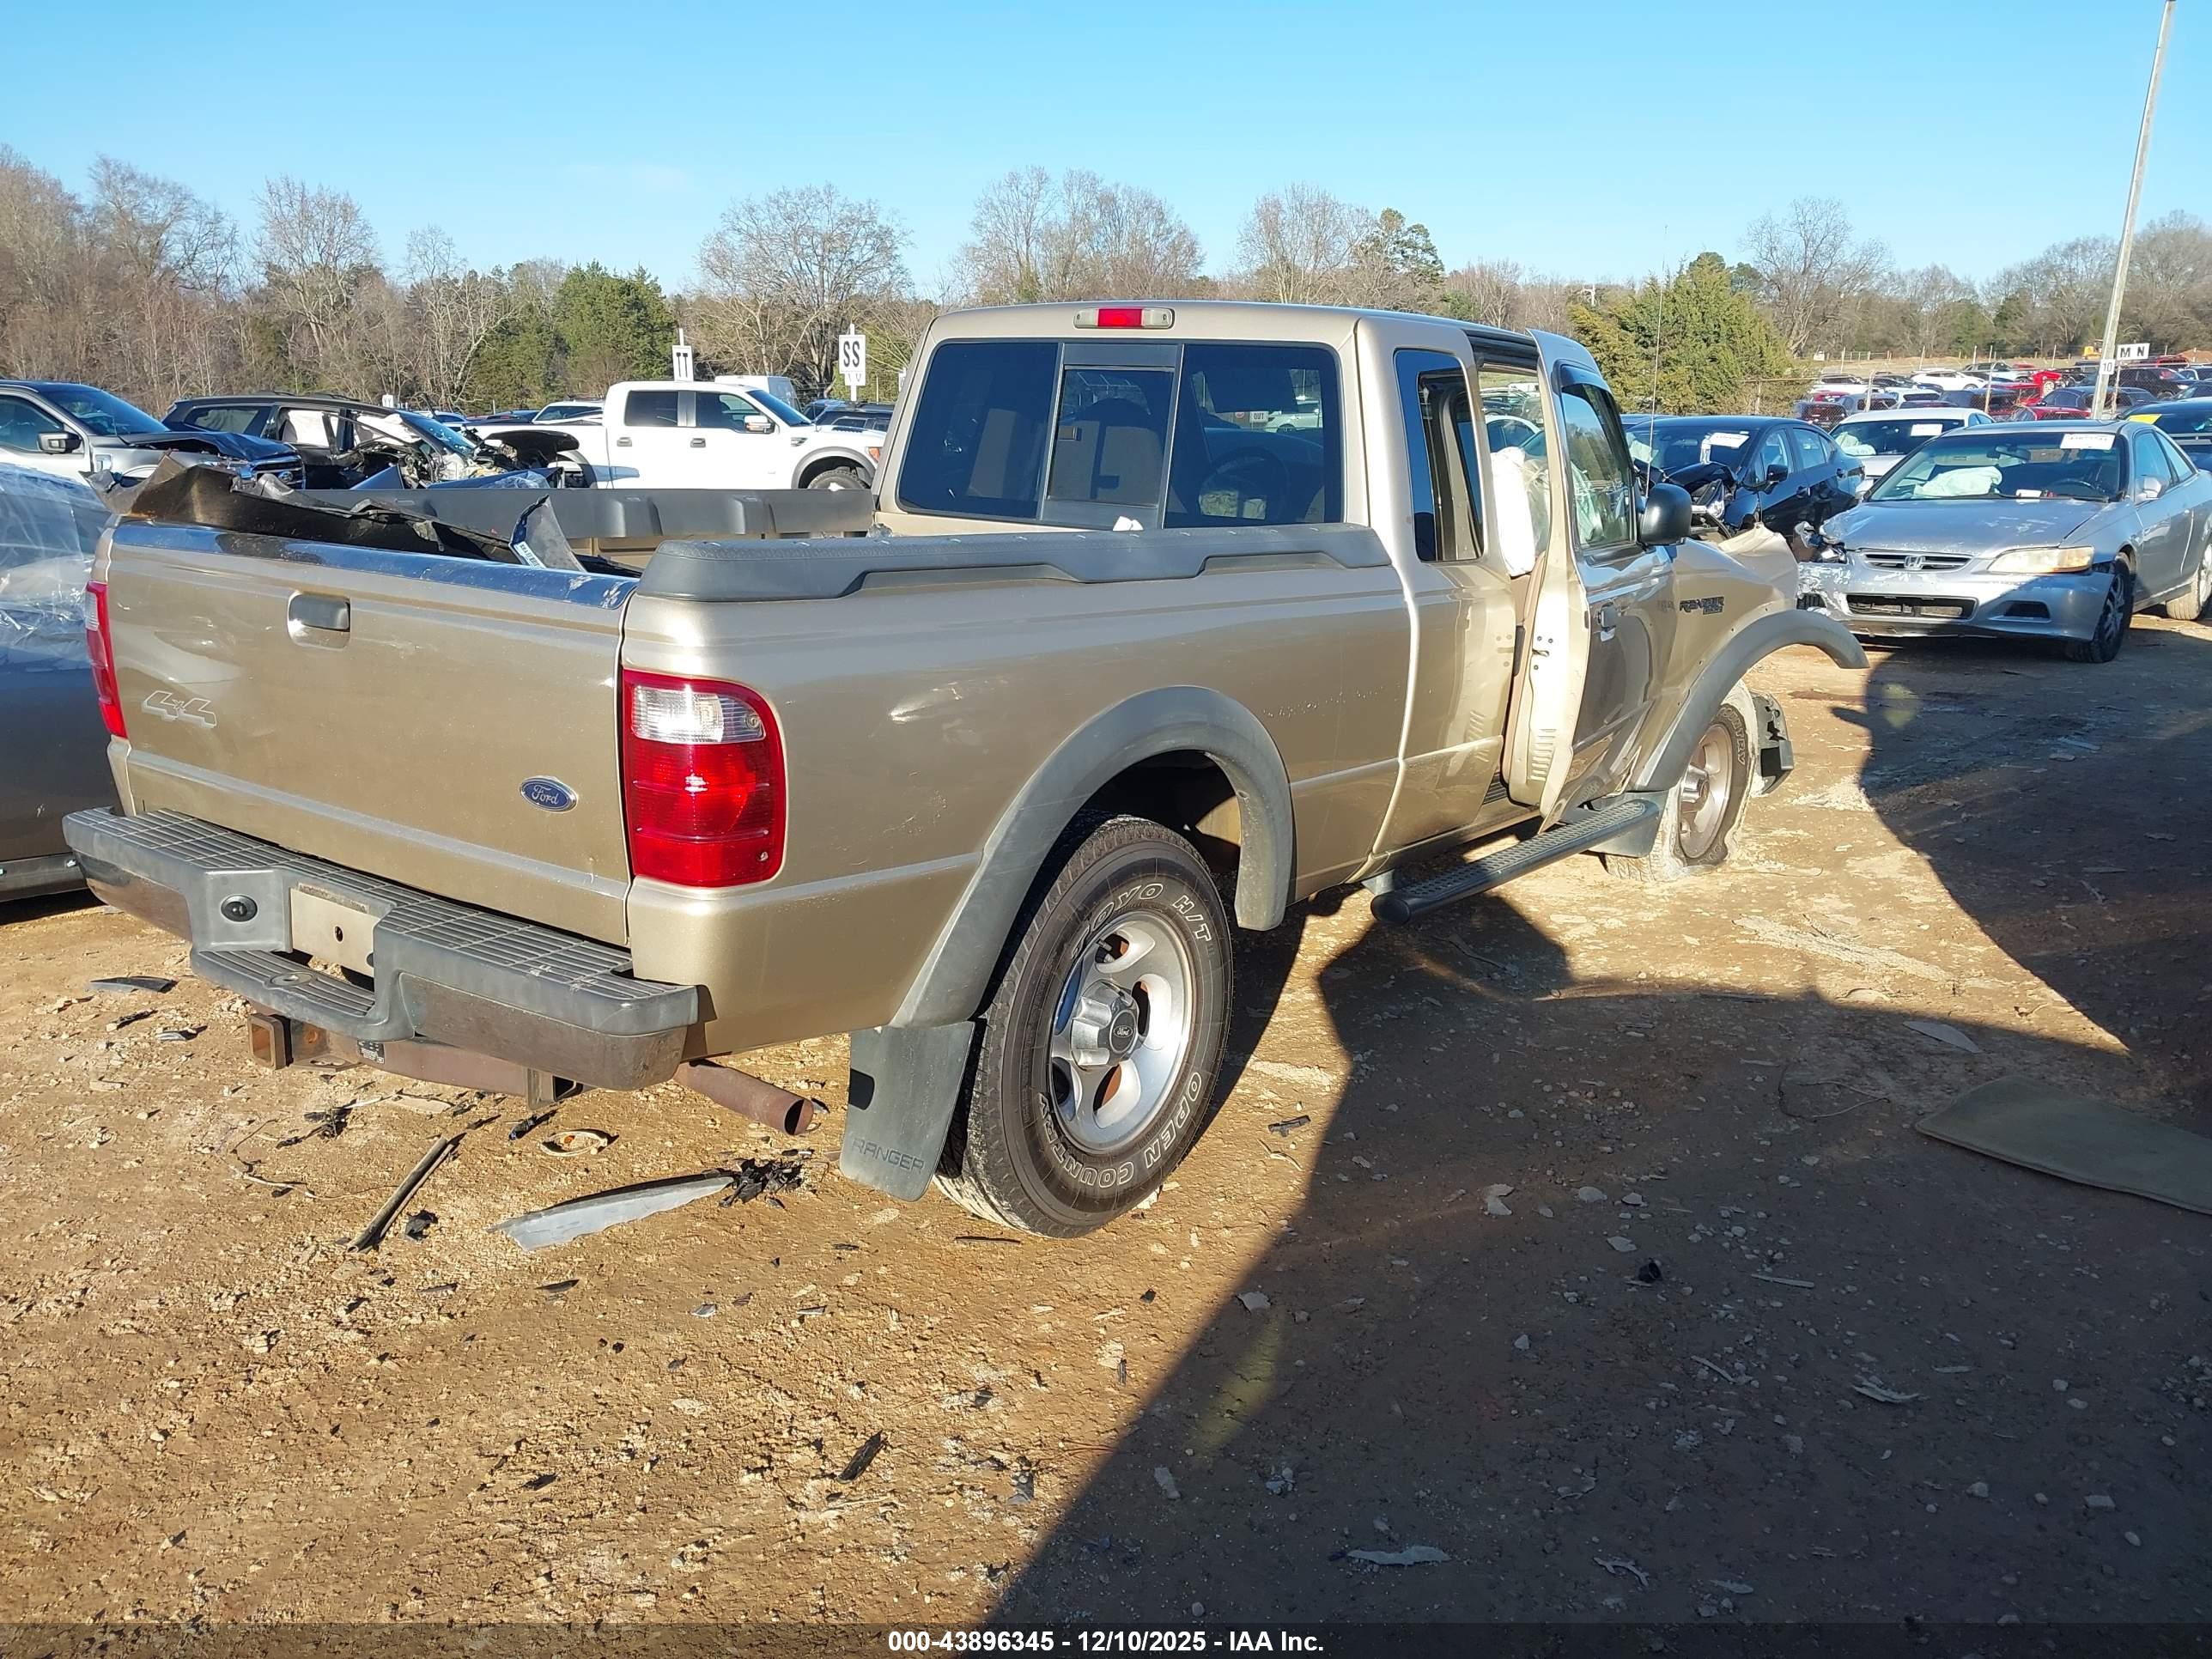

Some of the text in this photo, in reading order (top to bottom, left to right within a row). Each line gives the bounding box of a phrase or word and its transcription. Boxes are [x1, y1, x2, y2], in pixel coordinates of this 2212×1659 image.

[842, 340, 860, 368] SS
[2120, 345, 2145, 358] M N
[2102, 362, 2112, 373] 10
[531, 783, 562, 805] Ford
[1171, 894, 1212, 942] H/T
[1037, 1072, 1202, 1188] OPEN COUNTRY
[851, 1136, 925, 1175] RANGER
